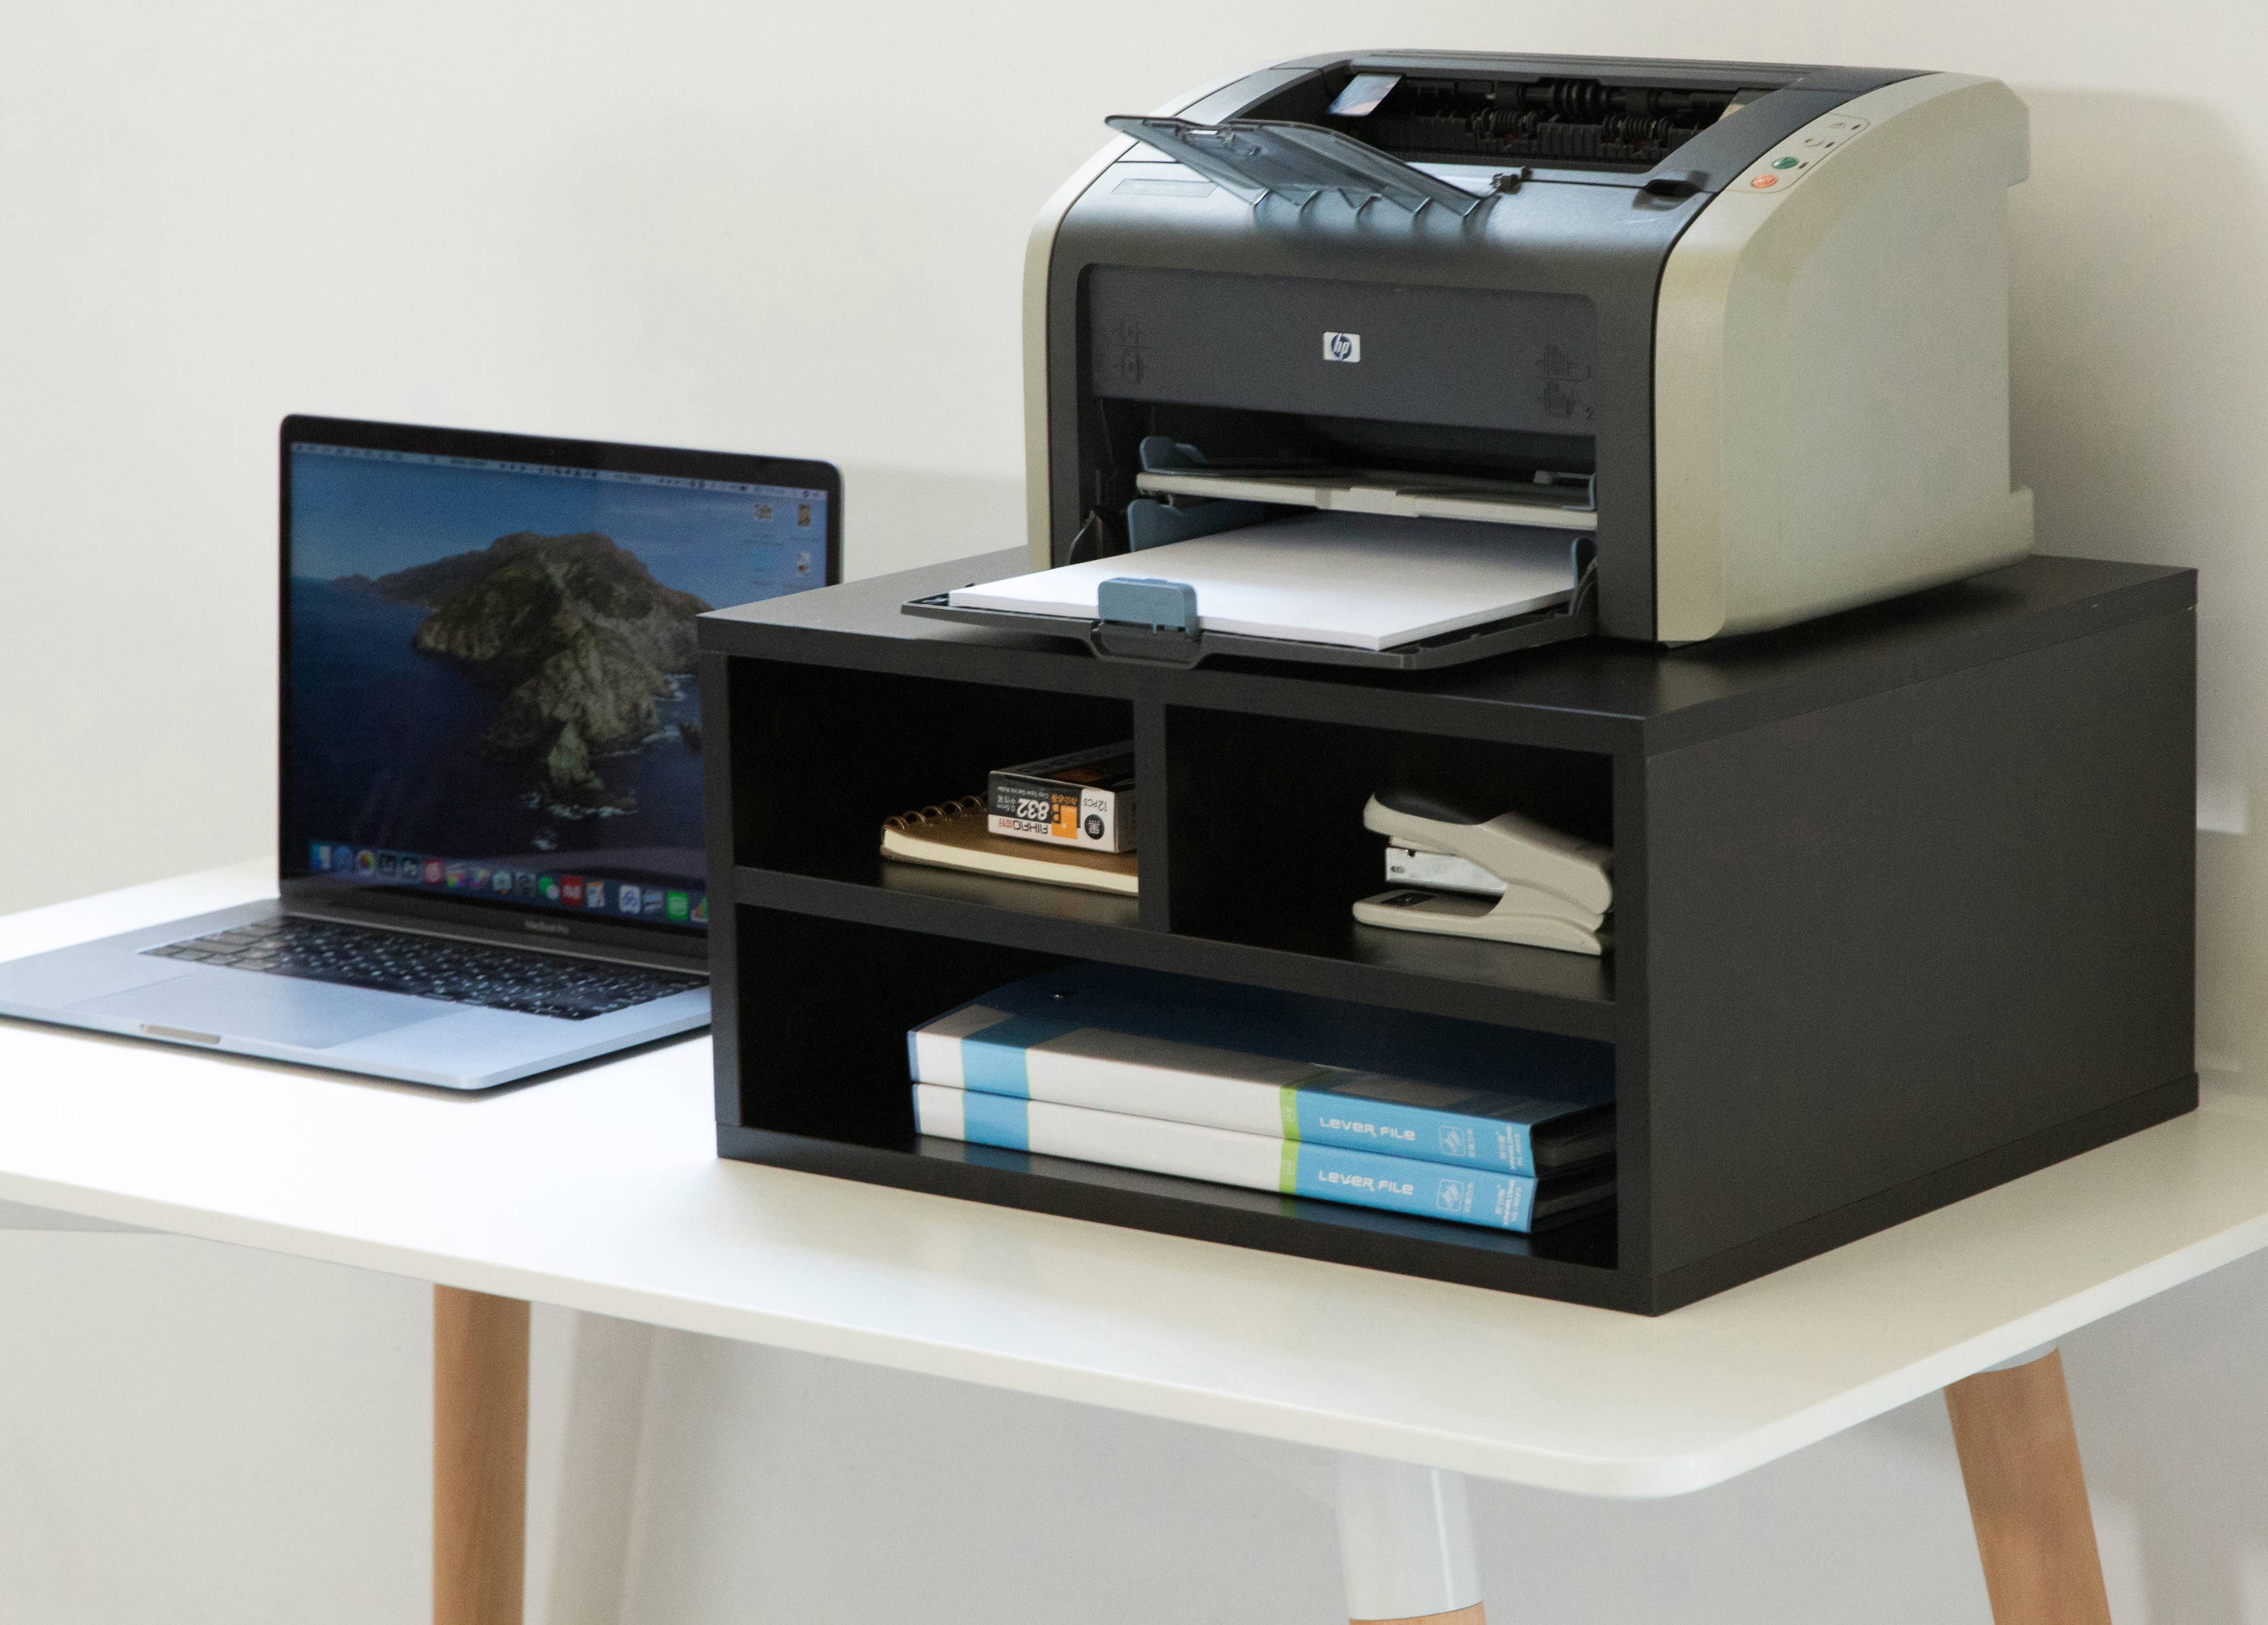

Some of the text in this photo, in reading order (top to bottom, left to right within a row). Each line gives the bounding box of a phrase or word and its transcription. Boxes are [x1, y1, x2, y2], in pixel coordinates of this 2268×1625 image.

[1331, 332, 1352, 362] hp
[1017, 798, 1050, 821] 832
[1083, 798, 1107, 812] 12PCS
[1013, 819, 1048, 834] AIHAO
[1319, 1117, 1416, 1141] LEVER FILE
[1318, 1170, 1414, 1196] LEVER FILE
